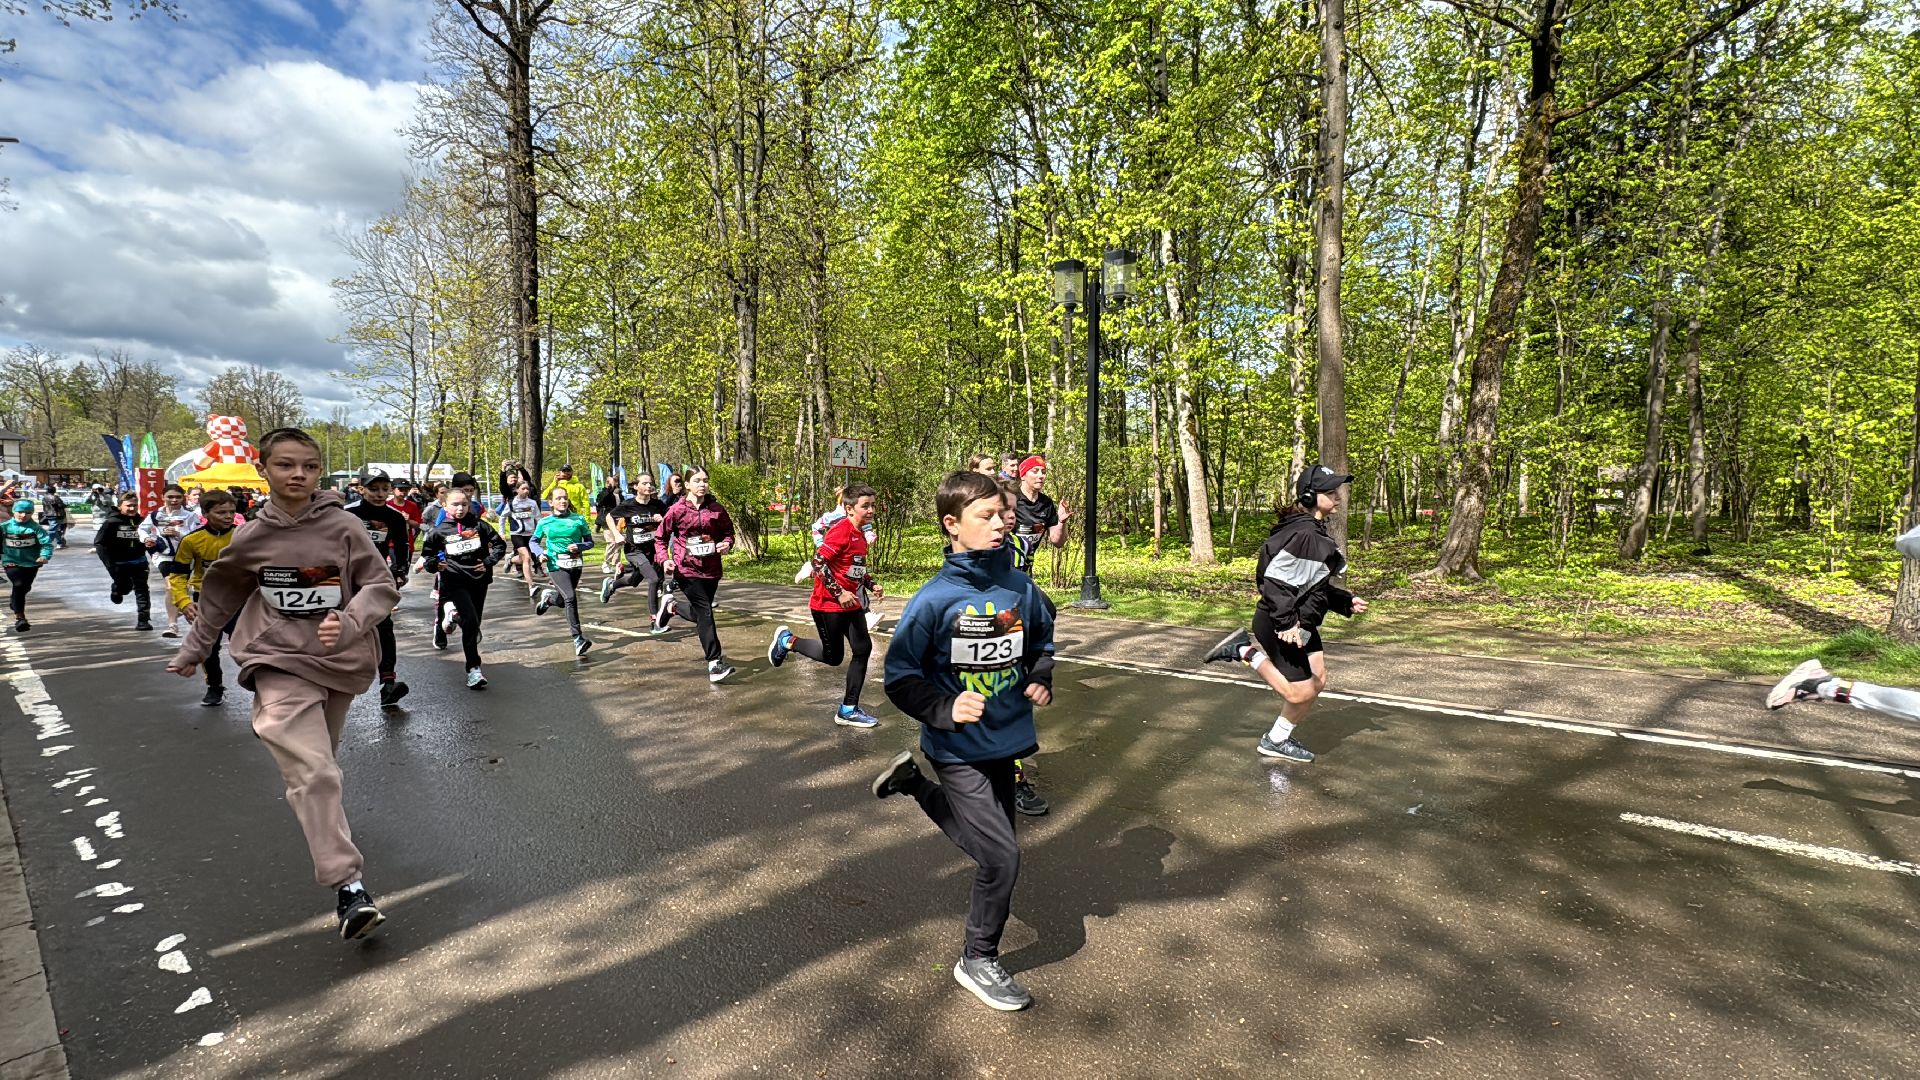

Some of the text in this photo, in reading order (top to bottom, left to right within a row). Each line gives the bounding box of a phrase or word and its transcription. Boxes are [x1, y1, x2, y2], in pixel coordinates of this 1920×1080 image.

[147, 470, 158, 514] СТАР
[456, 541, 472, 551] 95
[695, 545, 710, 553] 117
[273, 590, 326, 607] 124
[967, 638, 1012, 661] 123
